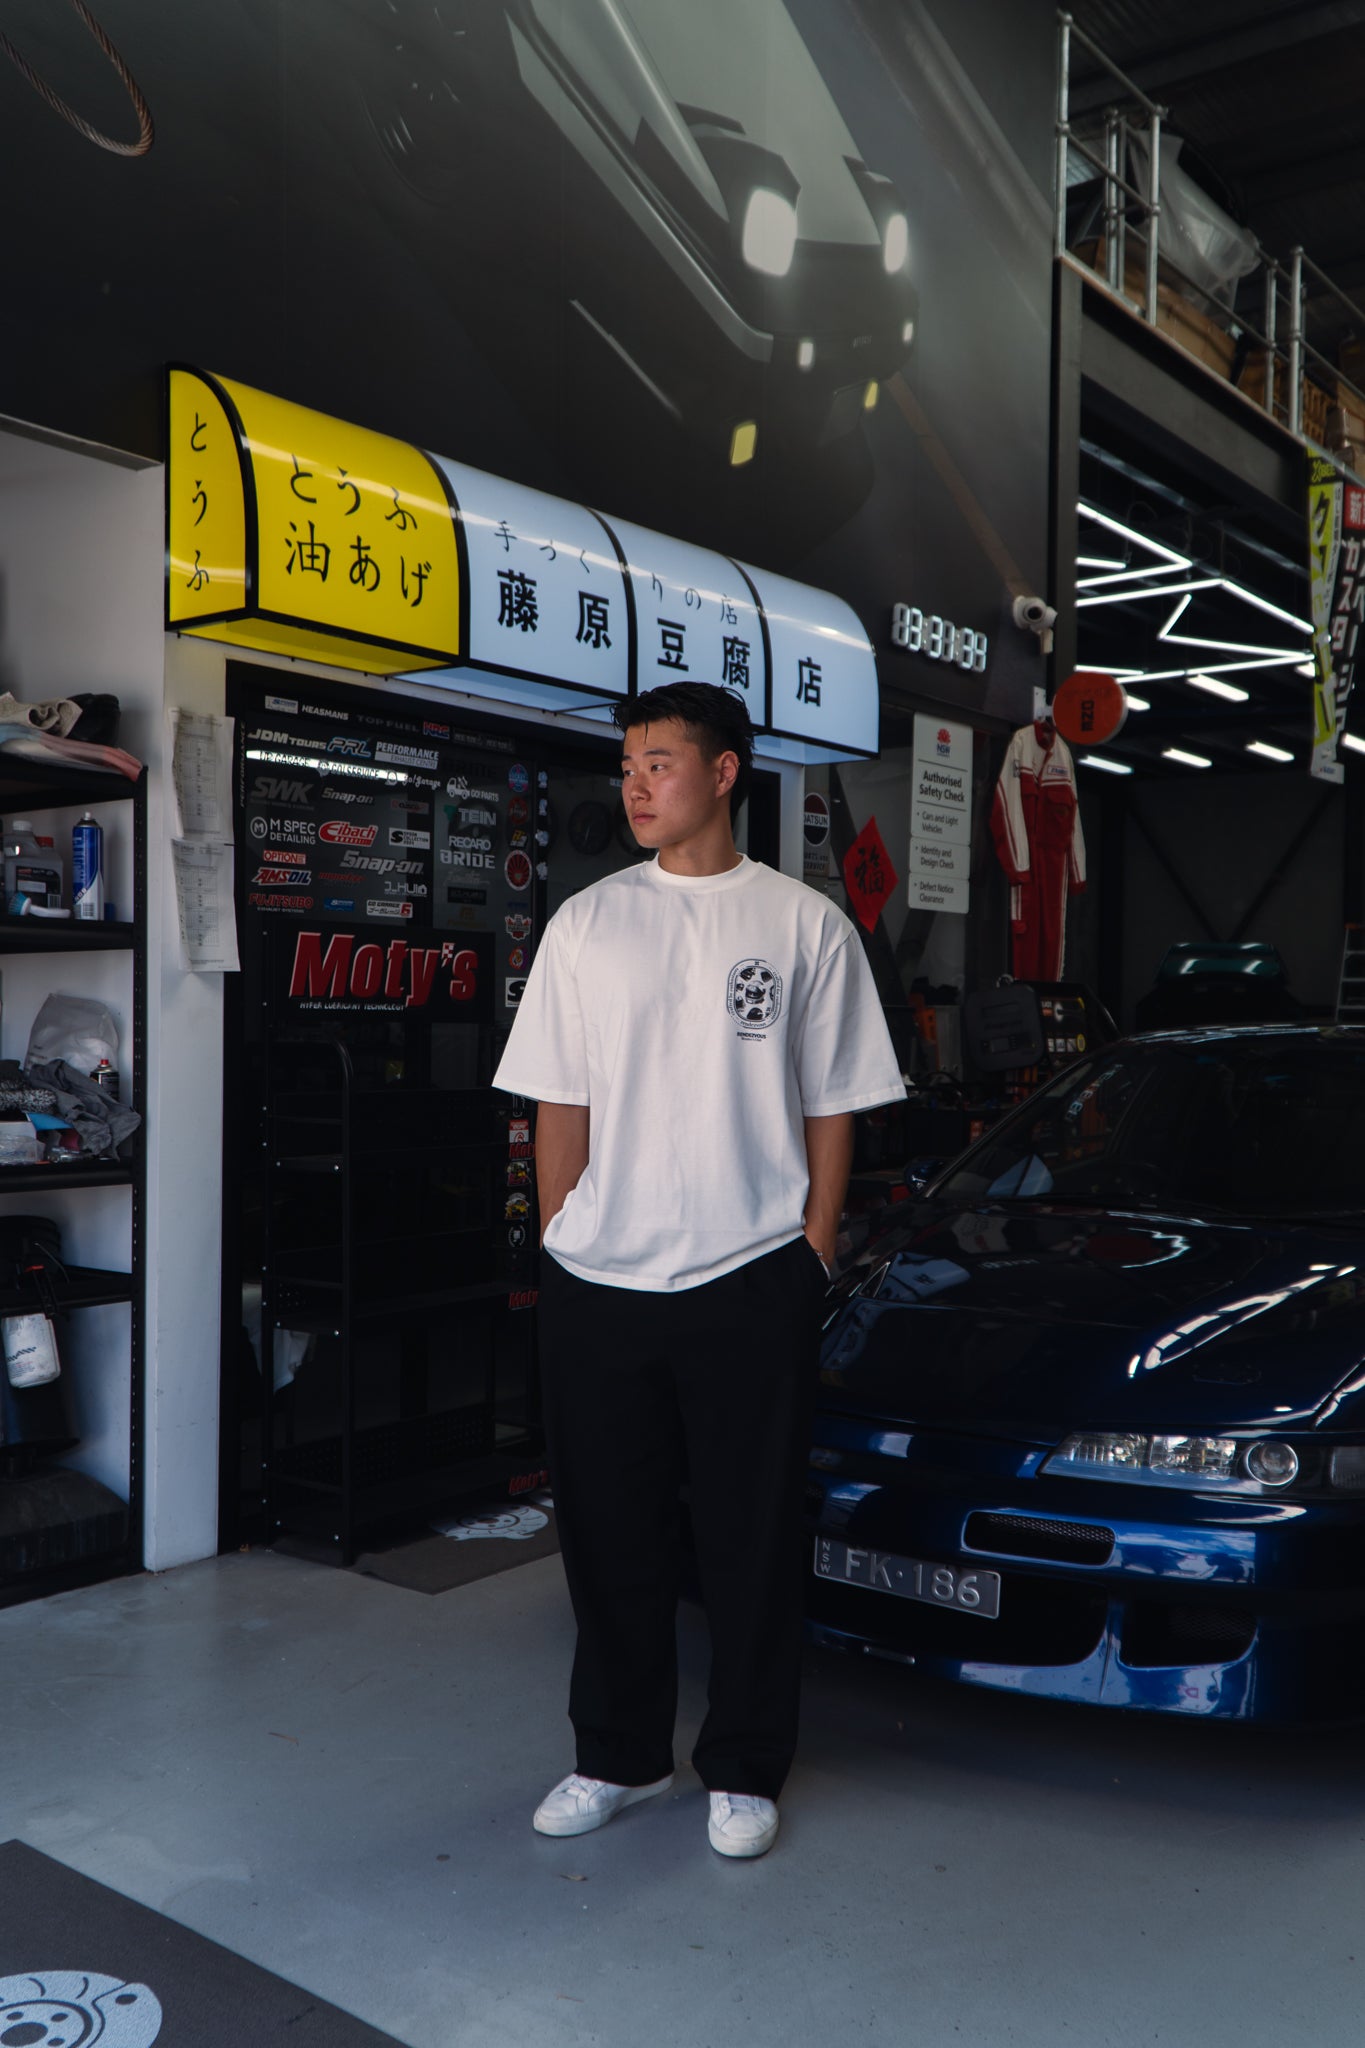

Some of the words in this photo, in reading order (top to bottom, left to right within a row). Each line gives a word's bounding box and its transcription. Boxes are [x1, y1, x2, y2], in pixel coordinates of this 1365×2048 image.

[187, 412, 209, 591] とうふ
[290, 454, 418, 531] とうふ
[285, 520, 432, 607] 油あげ
[497, 569, 822, 707] 藤原豆腐店
[247, 728, 289, 744] JDM
[289, 736, 327, 750] TOURS
[327, 736, 372, 758] PRL
[376, 741, 440, 761] PERFORMANCE
[923, 770, 962, 788] Authorised
[250, 776, 315, 804] SWK
[919, 784, 943, 801] Safety
[944, 788, 965, 802] Check
[458, 807, 497, 826] TEIN
[922, 811, 934, 821] Cars
[935, 815, 945, 823] and
[946, 816, 959, 827] Light
[270, 818, 280, 831] M
[284, 820, 316, 835] SPEC
[922, 823, 943, 834] Vehicles
[270, 831, 316, 845] DETAILING
[449, 835, 492, 851] RECARO
[440, 849, 496, 870] BRIDE
[921, 845, 941, 858] Identity
[942, 849, 952, 858] and
[920, 857, 938, 869] Design
[254, 868, 310, 884] AMSOIL
[920, 881, 937, 892] Defect
[938, 884, 954, 894] Notice
[249, 892, 314, 909] FUJITSUBO
[919, 893, 945, 904] Clearance
[289, 931, 479, 1008] Moty's
[820, 1541, 831, 1574] NSW
